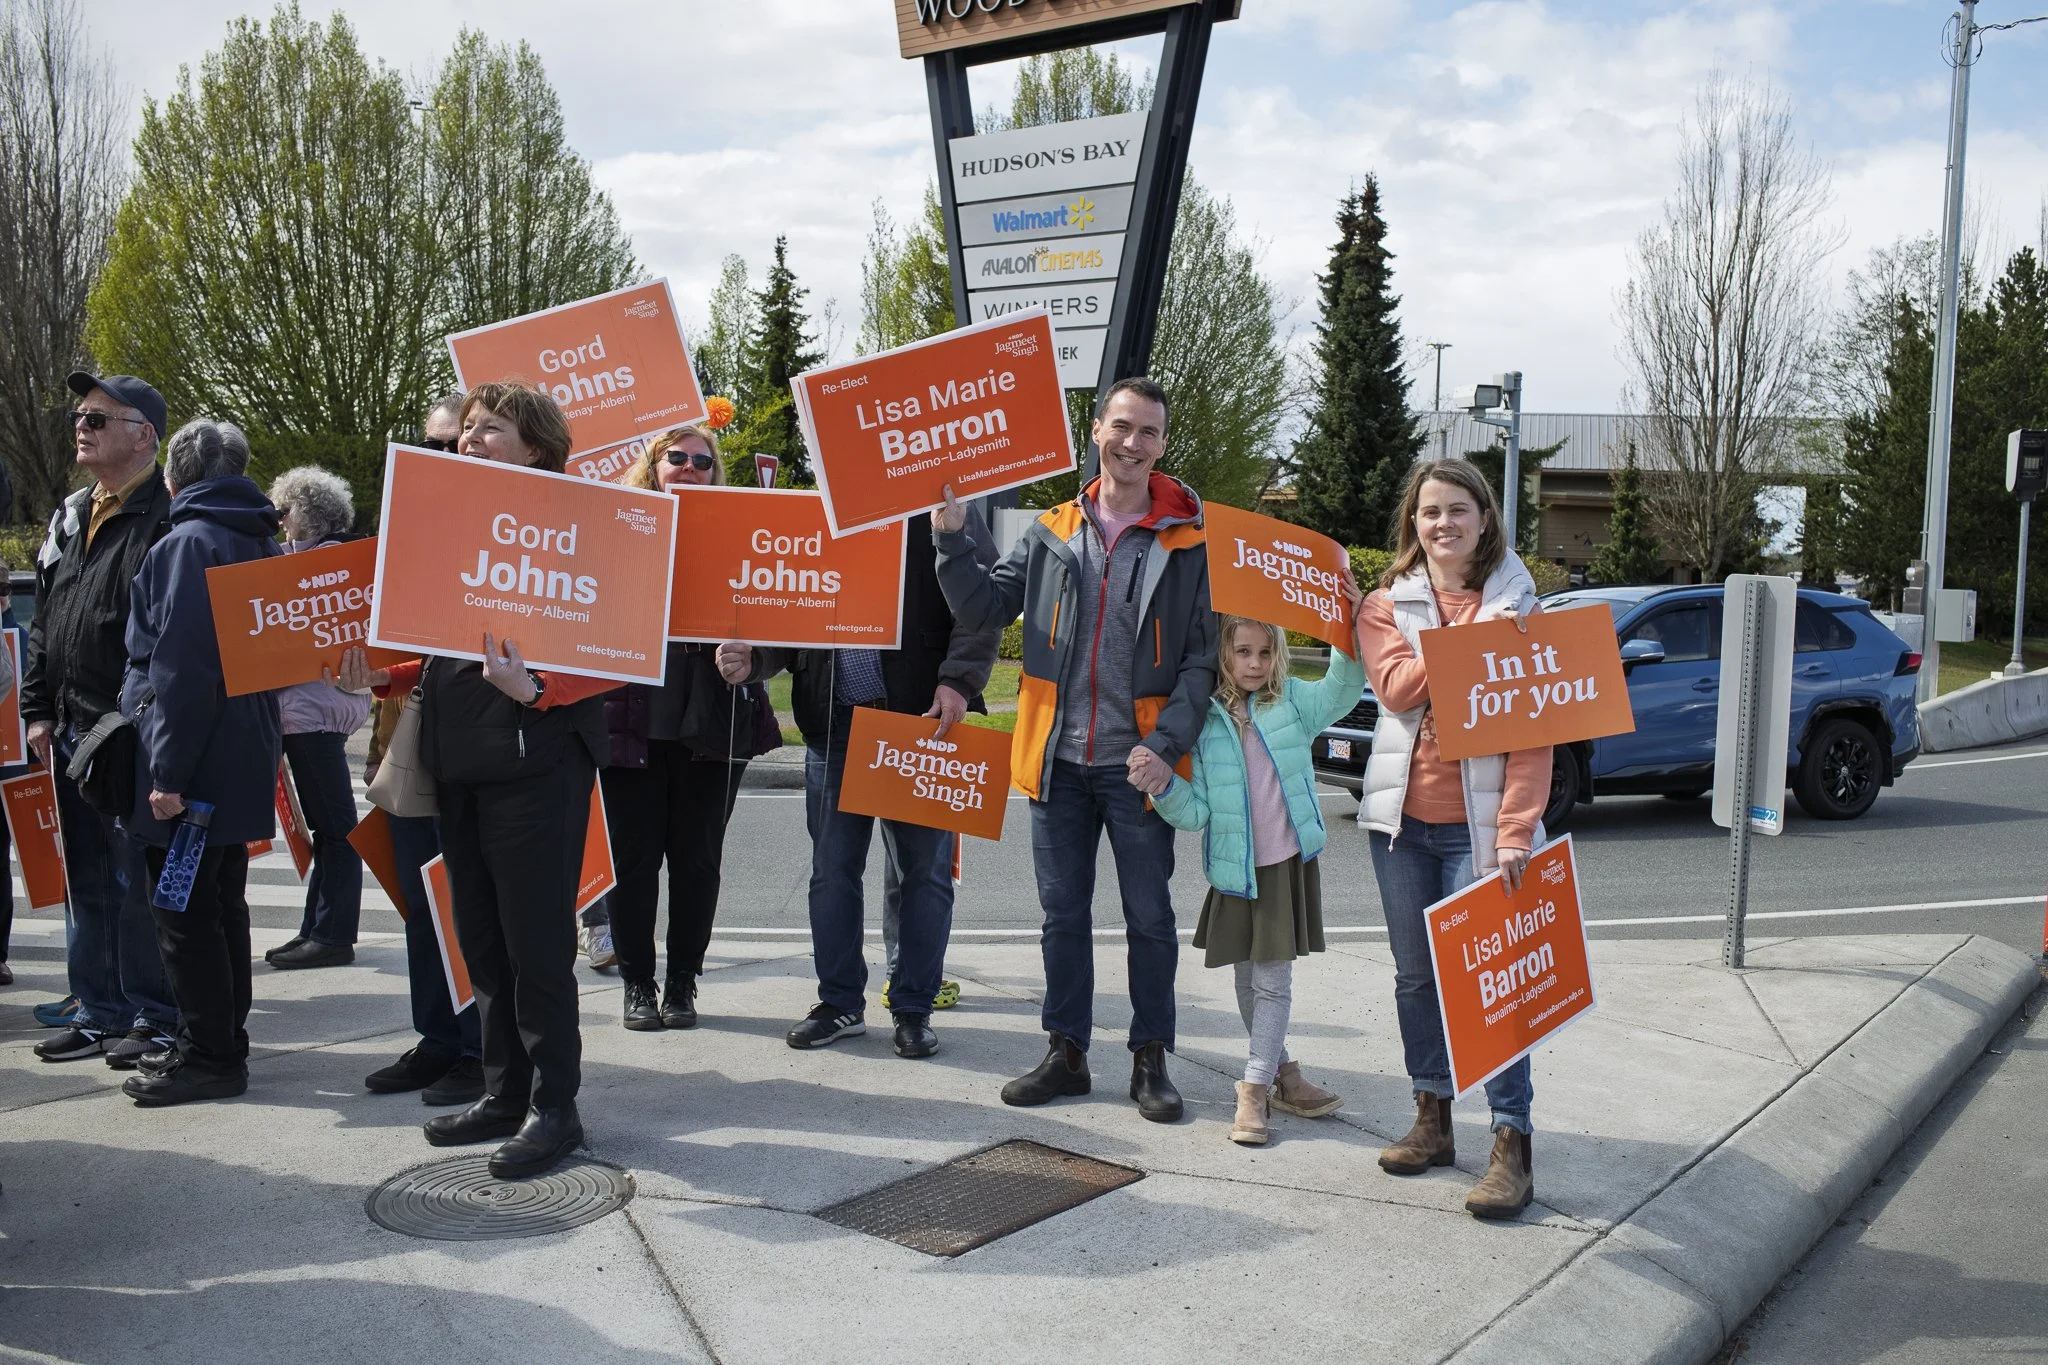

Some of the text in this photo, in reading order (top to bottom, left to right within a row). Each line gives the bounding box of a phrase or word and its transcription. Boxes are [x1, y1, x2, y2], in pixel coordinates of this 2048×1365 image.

[961, 139, 1131, 178] HUDSON'S BAY
[992, 205, 1068, 233] Walmart
[981, 249, 1103, 276] AVALON CINEMAS
[539, 334, 606, 373] Gord
[995, 333, 1037, 355] Jagmeet
[1012, 344, 1039, 358] Singh
[822, 374, 868, 395] Re-Elect
[856, 369, 1016, 431] Lisa Marie
[634, 402, 688, 424] reelectgord.ca
[879, 408, 1008, 463] Barron
[958, 450, 1057, 484] LisaMarieBarron.ndp.ca
[614, 508, 657, 525] Jagmeet
[630, 521, 656, 535] Singh
[492, 513, 577, 555] Gord
[751, 529, 822, 556] Gord
[1282, 542, 1313, 559] NDP
[311, 570, 350, 589] NDP
[460, 550, 598, 604] Johns
[728, 559, 842, 594] Johns
[1232, 537, 1342, 598] Jagmeet
[249, 583, 375, 636] Jagmee
[1281, 579, 1344, 624] Singh
[825, 624, 884, 633] reelectgord.ca
[576, 643, 646, 661] reelectgord.ca
[1482, 642, 1562, 683] In it
[1463, 675, 1599, 730] for you
[868, 740, 989, 785] Jagmeet
[926, 739, 958, 753] NDP
[13, 785, 44, 800] Re-Elect
[912, 775, 983, 812] Singh
[1765, 810, 1777, 822] 22
[1439, 908, 1469, 933] Re-Elect
[1462, 898, 1556, 972] Lisa Marie
[1478, 942, 1555, 1010] Barron
[1528, 987, 1585, 1029] LisaMarieBarron.ndp.ca
